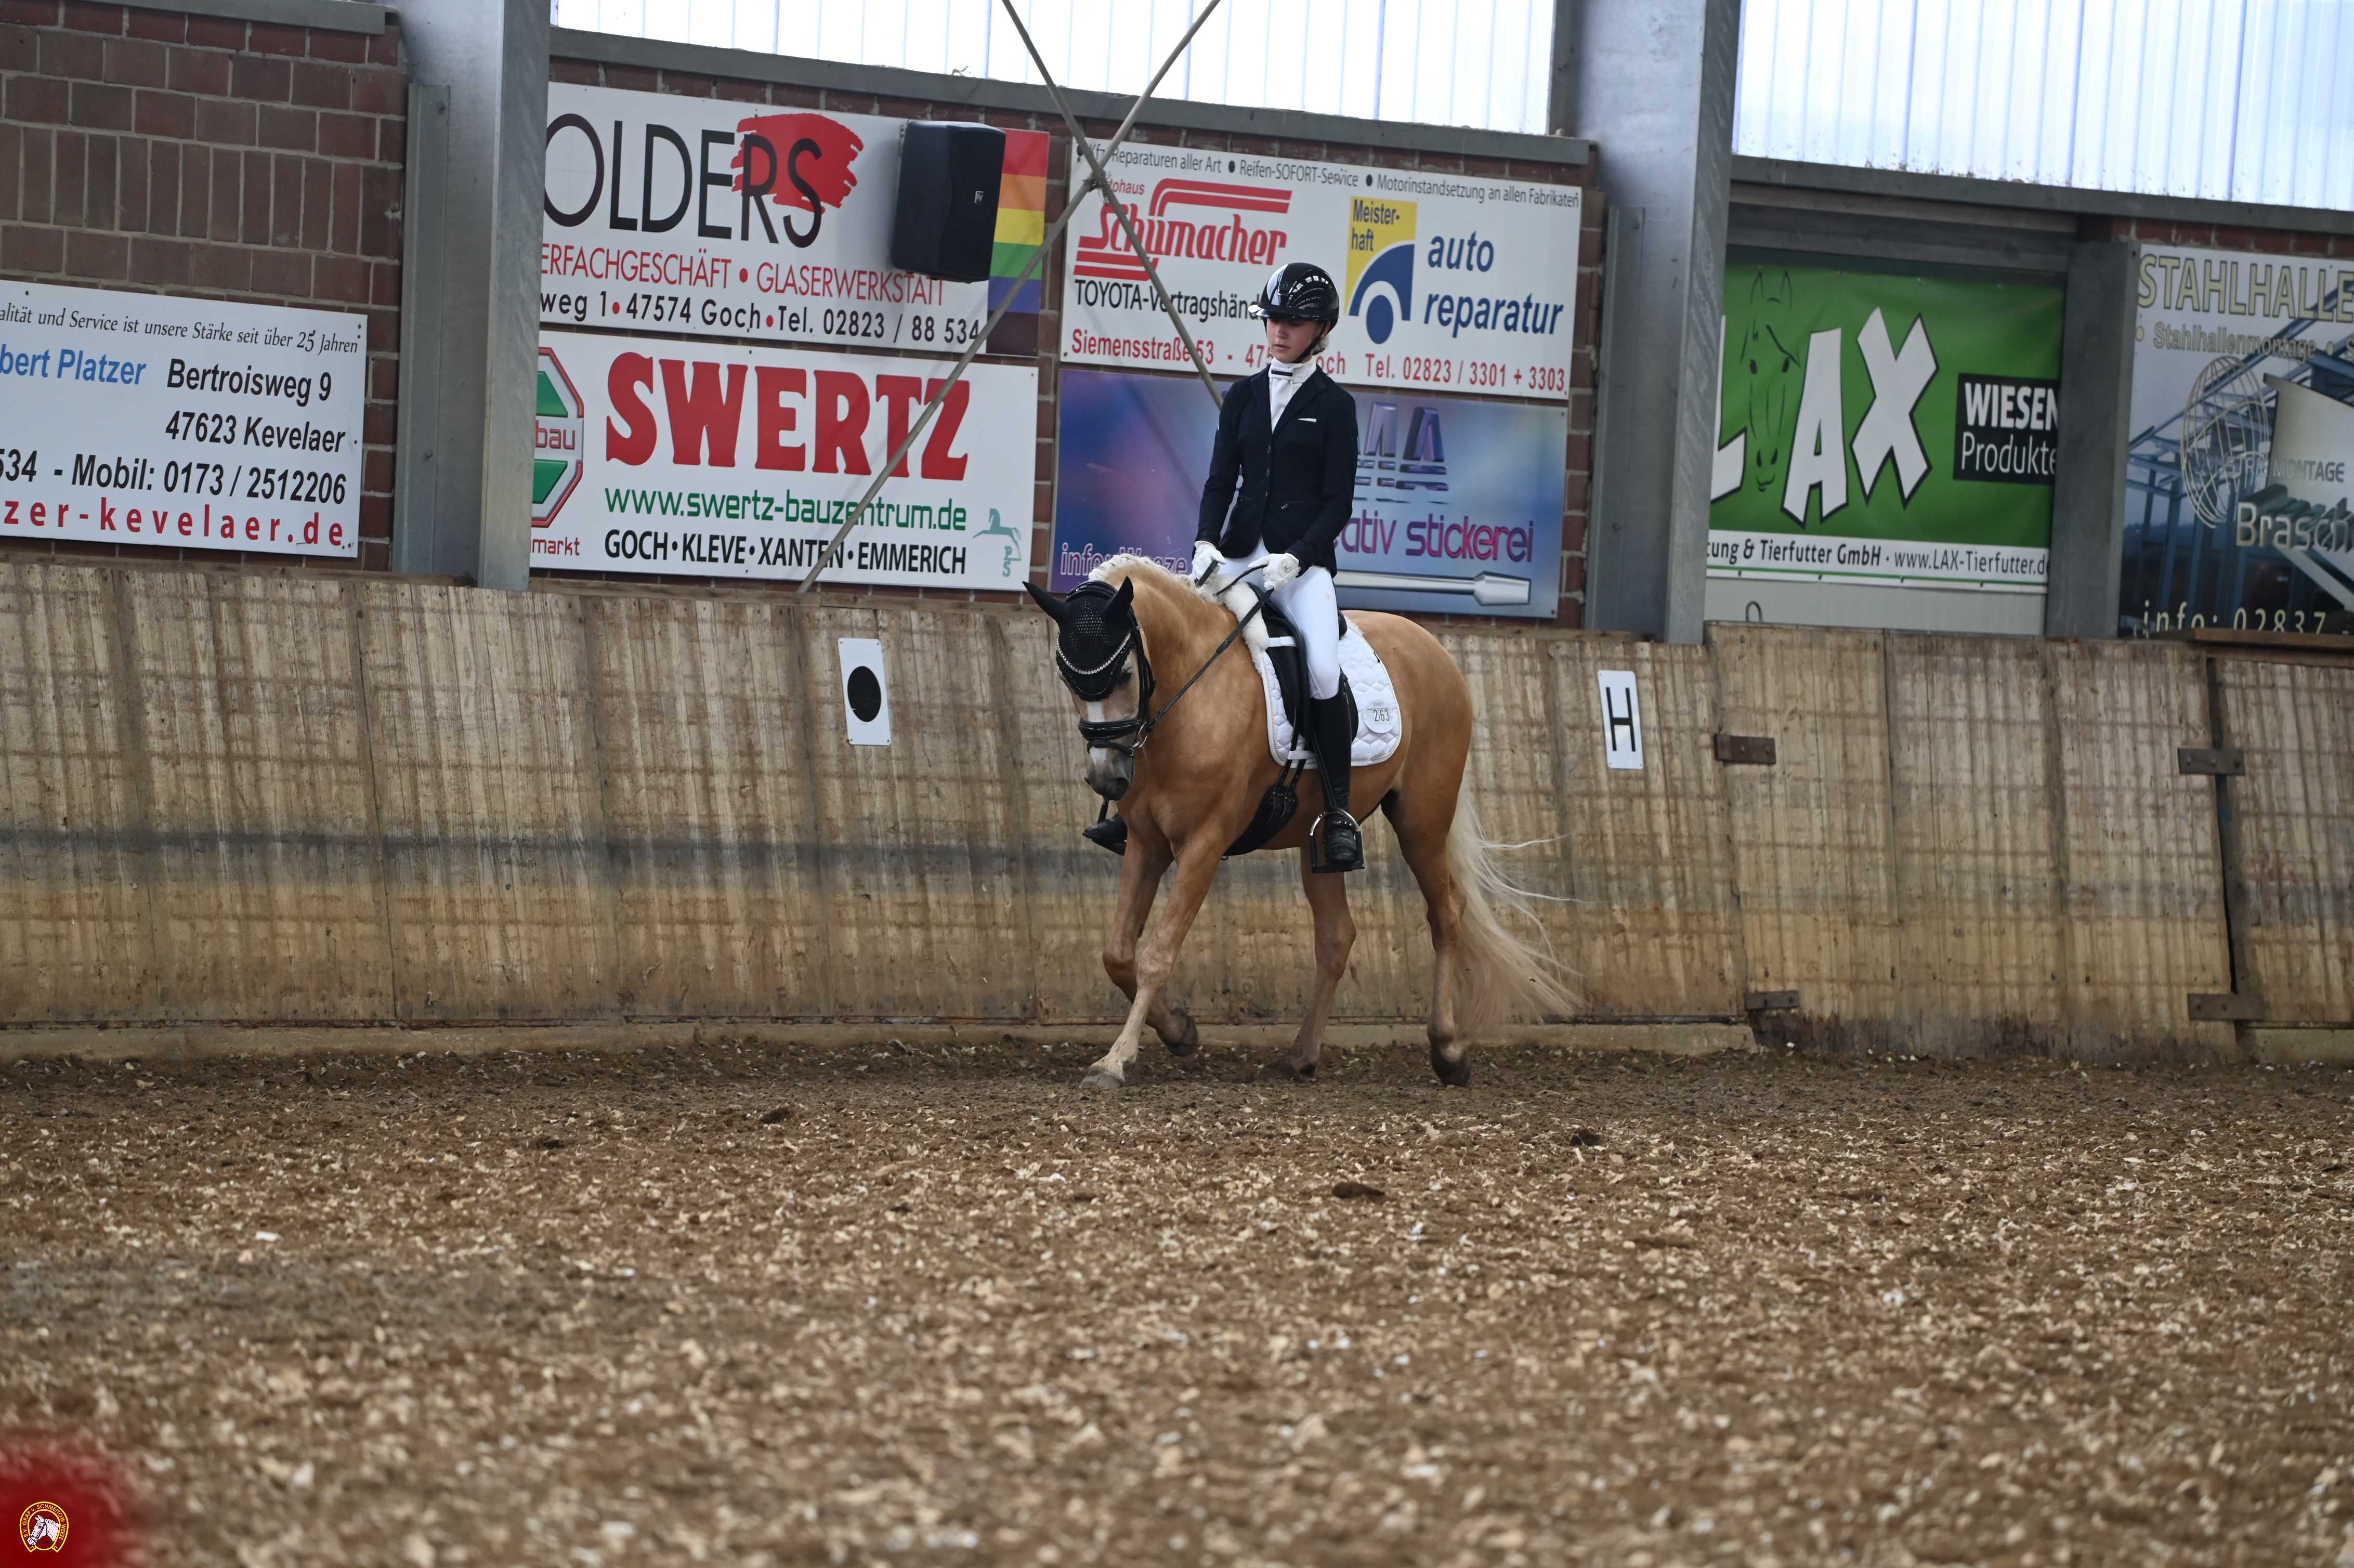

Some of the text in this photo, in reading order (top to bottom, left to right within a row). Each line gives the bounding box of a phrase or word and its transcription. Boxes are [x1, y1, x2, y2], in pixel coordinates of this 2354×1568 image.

[1180, 153, 1204, 171] aller
[1205, 156, 1222, 173] Art
[1239, 159, 1359, 187] Reifen-SOFORT-Service
[1377, 173, 1579, 208] Motorinstandsetzung an allen Fabrikaten
[1352, 199, 1400, 225] Meister-
[1078, 203, 1287, 266] Schumacher
[1352, 227, 1375, 252] haft
[1428, 230, 1495, 272] auto
[600, 291, 607, 317] 1
[757, 262, 944, 306] GLASERWERKSTATT
[1075, 279, 1264, 322] TOYOTA-Vrtragshänd
[38, 308, 66, 326] und
[69, 310, 118, 331] Service
[123, 316, 140, 333] ist
[144, 322, 188, 337] unsere
[192, 322, 233, 342] Stärke
[237, 328, 259, 344] seit
[264, 327, 293, 347] über
[296, 330, 316, 352] 25
[317, 333, 358, 356] Jahren
[626, 293, 761, 329] 47574 Goch
[778, 305, 980, 344] Tel. 02823 / 88 534
[1423, 292, 1564, 338] reparatur
[1071, 328, 1191, 362] Siemensstraße
[1196, 339, 1214, 364] 53
[1318, 351, 1345, 375] och
[2153, 321, 2317, 363] Stahlhallenmontage
[0, 344, 147, 385] bert Platzer
[166, 358, 332, 407] Bertroisweg 9
[1365, 354, 1565, 391] Tel. 02823 / 3301 + 3303
[165, 410, 346, 453] 47623 Kevelaer
[606, 351, 971, 481] SWERTZ
[71, 453, 155, 491] Mobil:
[163, 460, 224, 497] 0173
[230, 465, 242, 498] /
[247, 466, 347, 505] 2512206
[2272, 458, 2345, 482] MONTAGE
[604, 488, 966, 531] www.swertz-bauzentrum.de
[605, 529, 668, 560] GOCH
[682, 532, 747, 564] KLEVE
[857, 541, 966, 574] EMMERICH
[1334, 509, 1534, 563] ativ stickerei
[1707, 538, 1881, 566] ung & Tierfutter GmbH
[1373, 709, 1390, 722] 263
[1605, 686, 1636, 752] H
